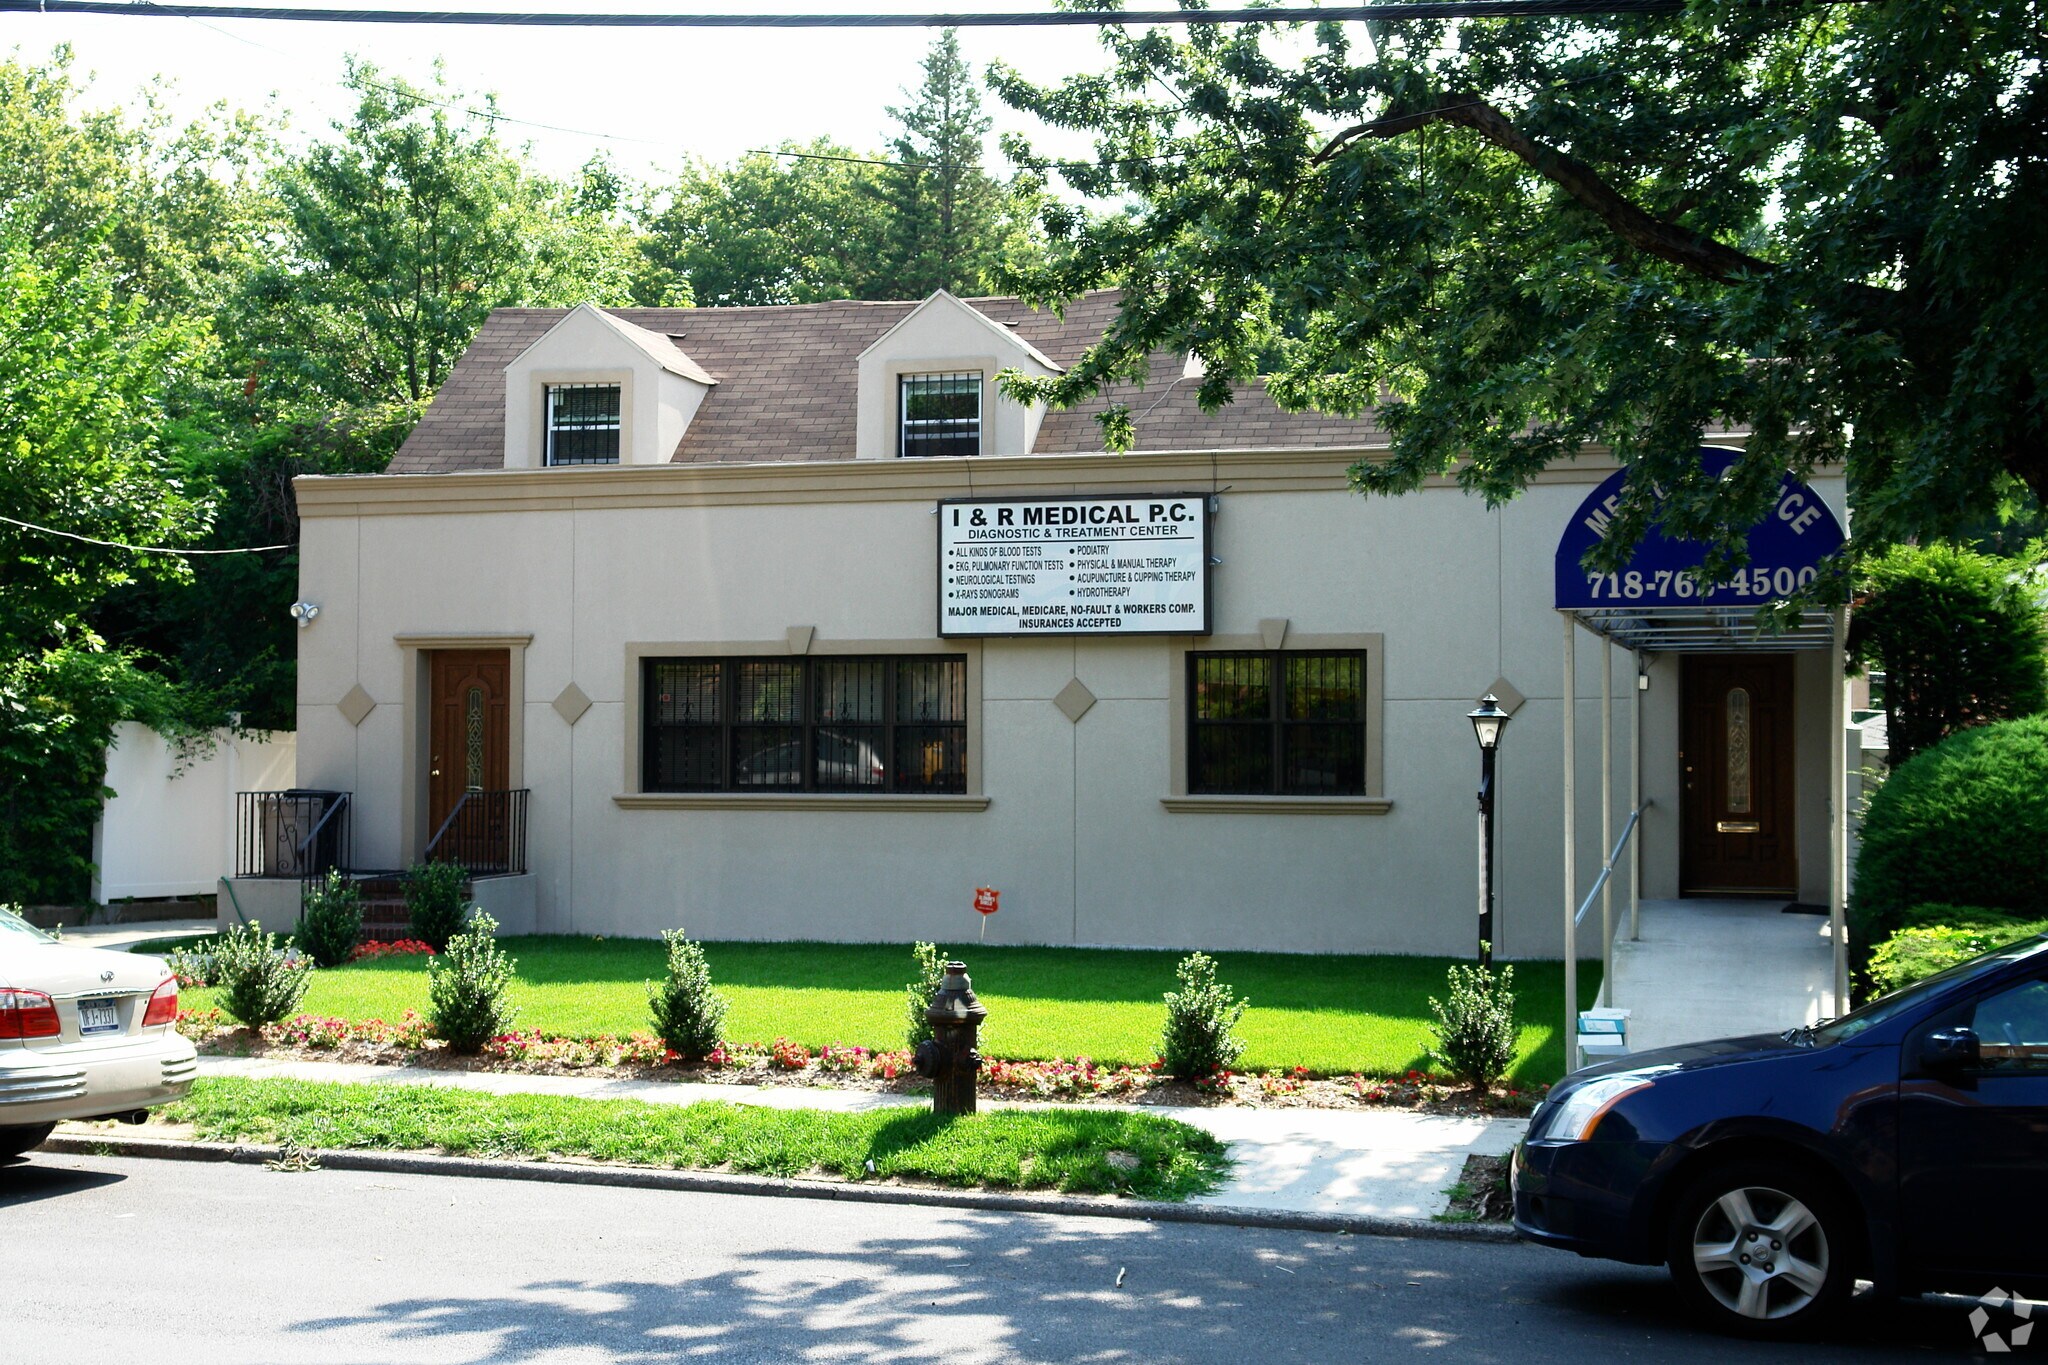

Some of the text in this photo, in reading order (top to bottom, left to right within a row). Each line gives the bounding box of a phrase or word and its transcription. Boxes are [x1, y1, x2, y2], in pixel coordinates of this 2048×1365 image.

[953, 503, 1195, 527] I & R MEDICAL P.C.
[968, 525, 1178, 539] DIAGNOSTIC & TREATMENT CENTER
[955, 546, 1042, 557] ALL KINDS OF BLOOD TESTS
[1077, 545, 1110, 555] PODIATRY
[956, 560, 1064, 572] EKG, PULMONARY FUNCTION TESTS
[1077, 557, 1177, 569] PHYSICAL & MANUAL THERAPY
[956, 574, 1036, 585] NEUROLOGICAL TESTINGS
[1077, 571, 1196, 583] ACUPUNCTURE & CUPPING THERAPY
[956, 588, 1019, 599] X-RAYS SONOGRAMS
[1077, 586, 1131, 597] HYDROTHERAPY
[948, 603, 1196, 617] MAJOR MEDICAL, MEDICARE, NO-FAULT & WORKERS COMP.
[1019, 617, 1122, 629] INSURANCES ACCEPTED
